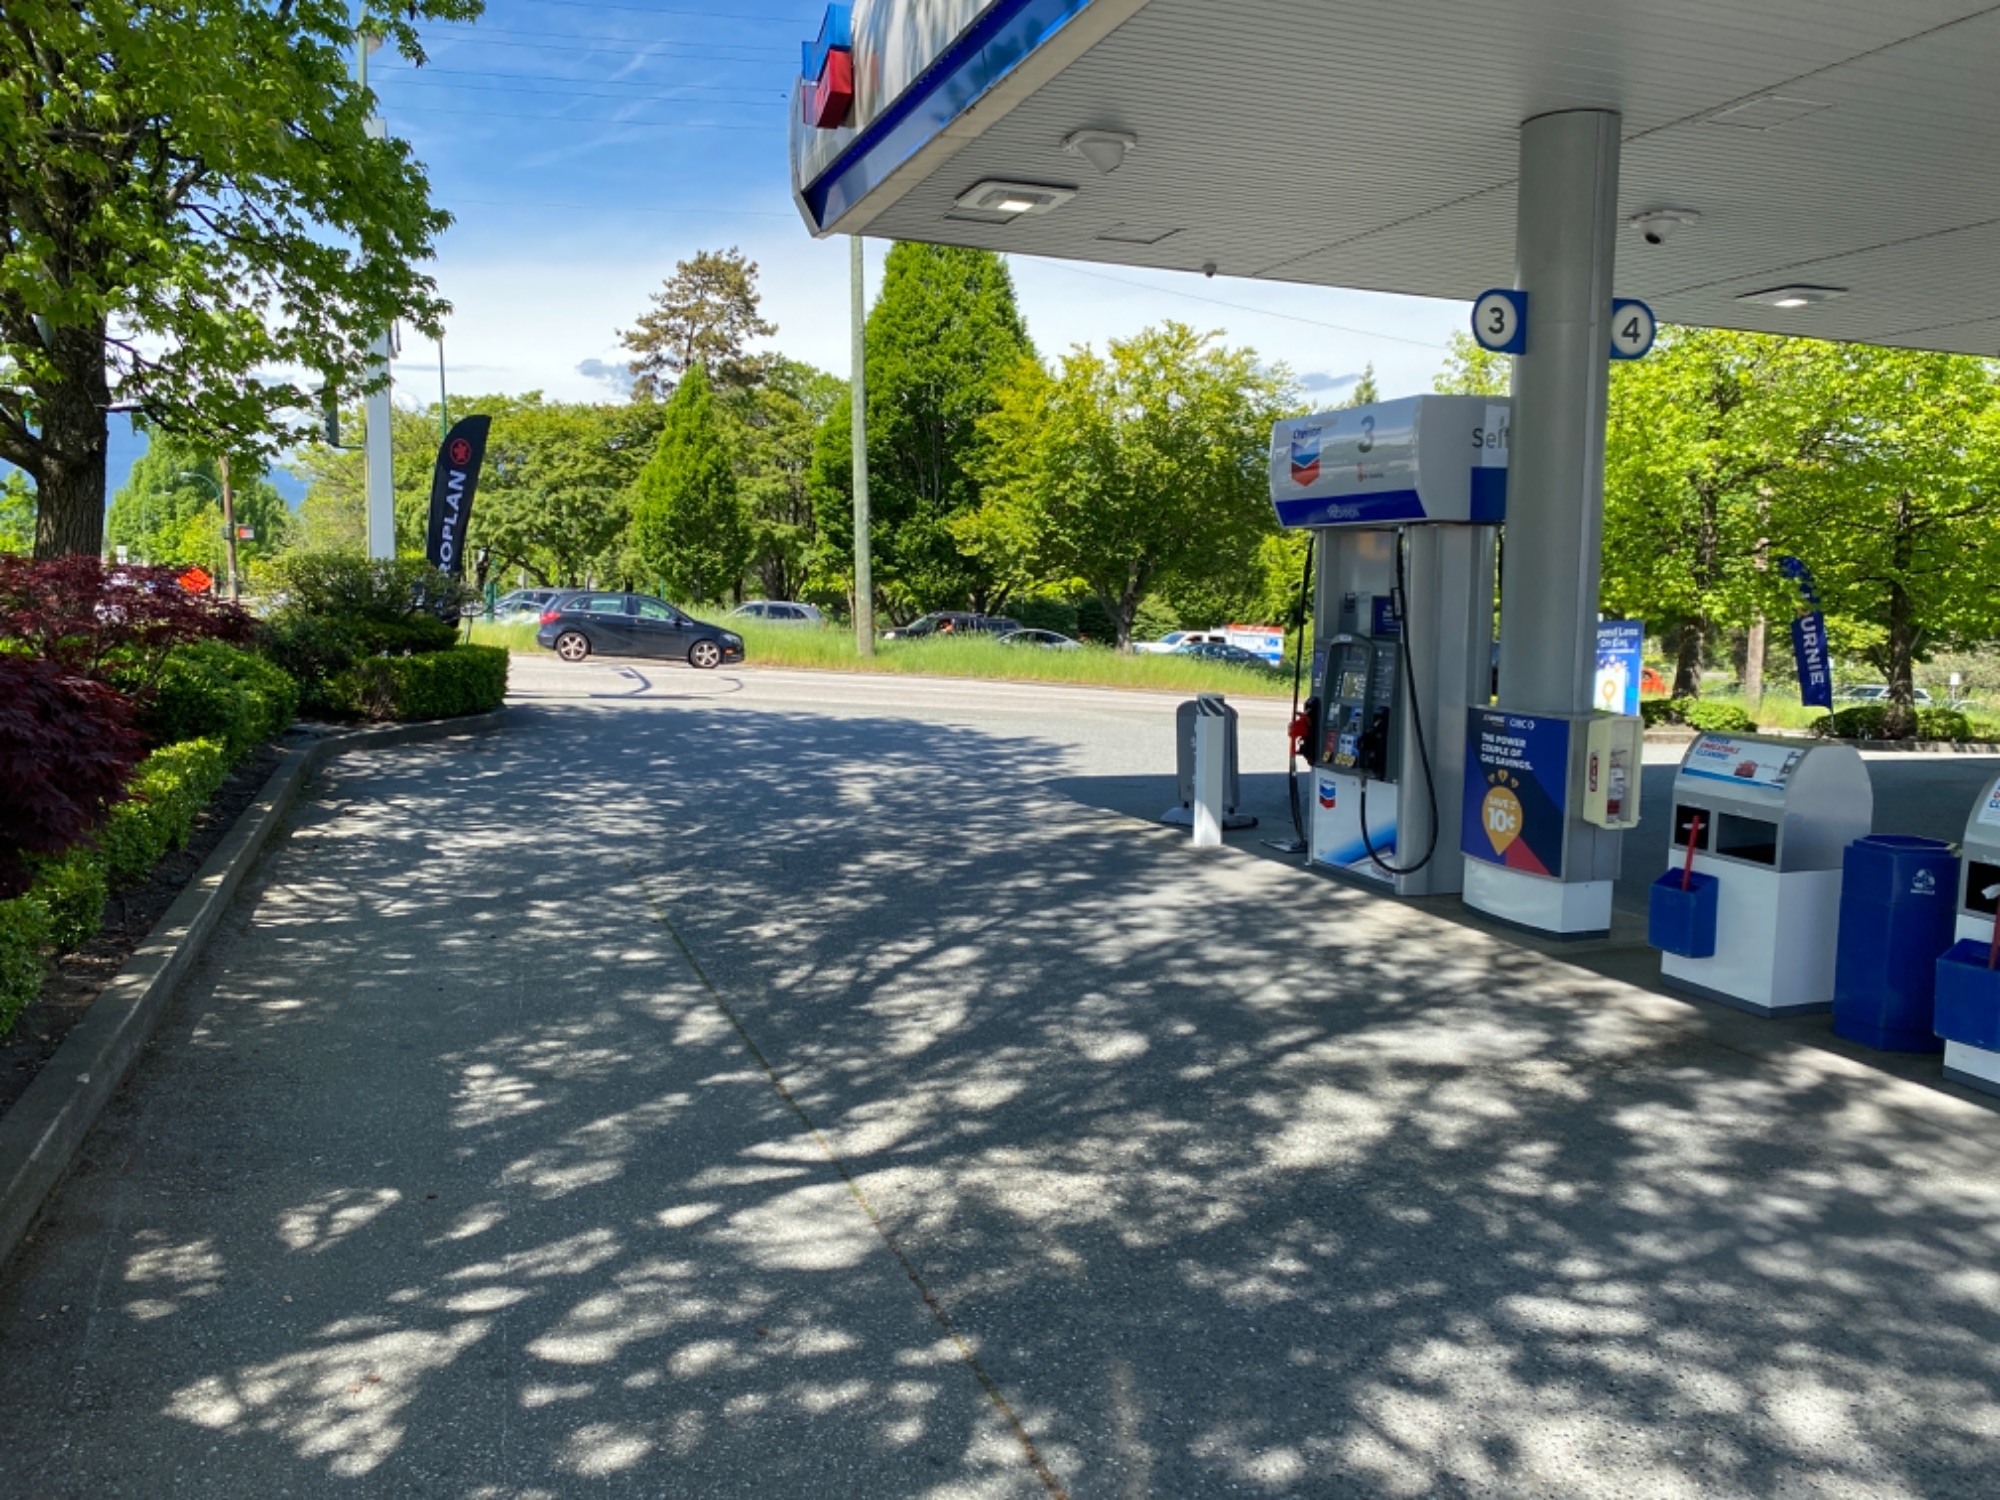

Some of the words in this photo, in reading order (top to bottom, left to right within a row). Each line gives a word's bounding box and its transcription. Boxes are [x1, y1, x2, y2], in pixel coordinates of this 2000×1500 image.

[1488, 307, 1505, 334] 3
[1622, 317, 1641, 343] 4
[1357, 415, 1376, 453] 3
[438, 470, 467, 578] ROPLAN
[1597, 626, 1618, 639] pend
[1798, 592, 1825, 686] URNIE
[1495, 735, 1527, 749] POWER
